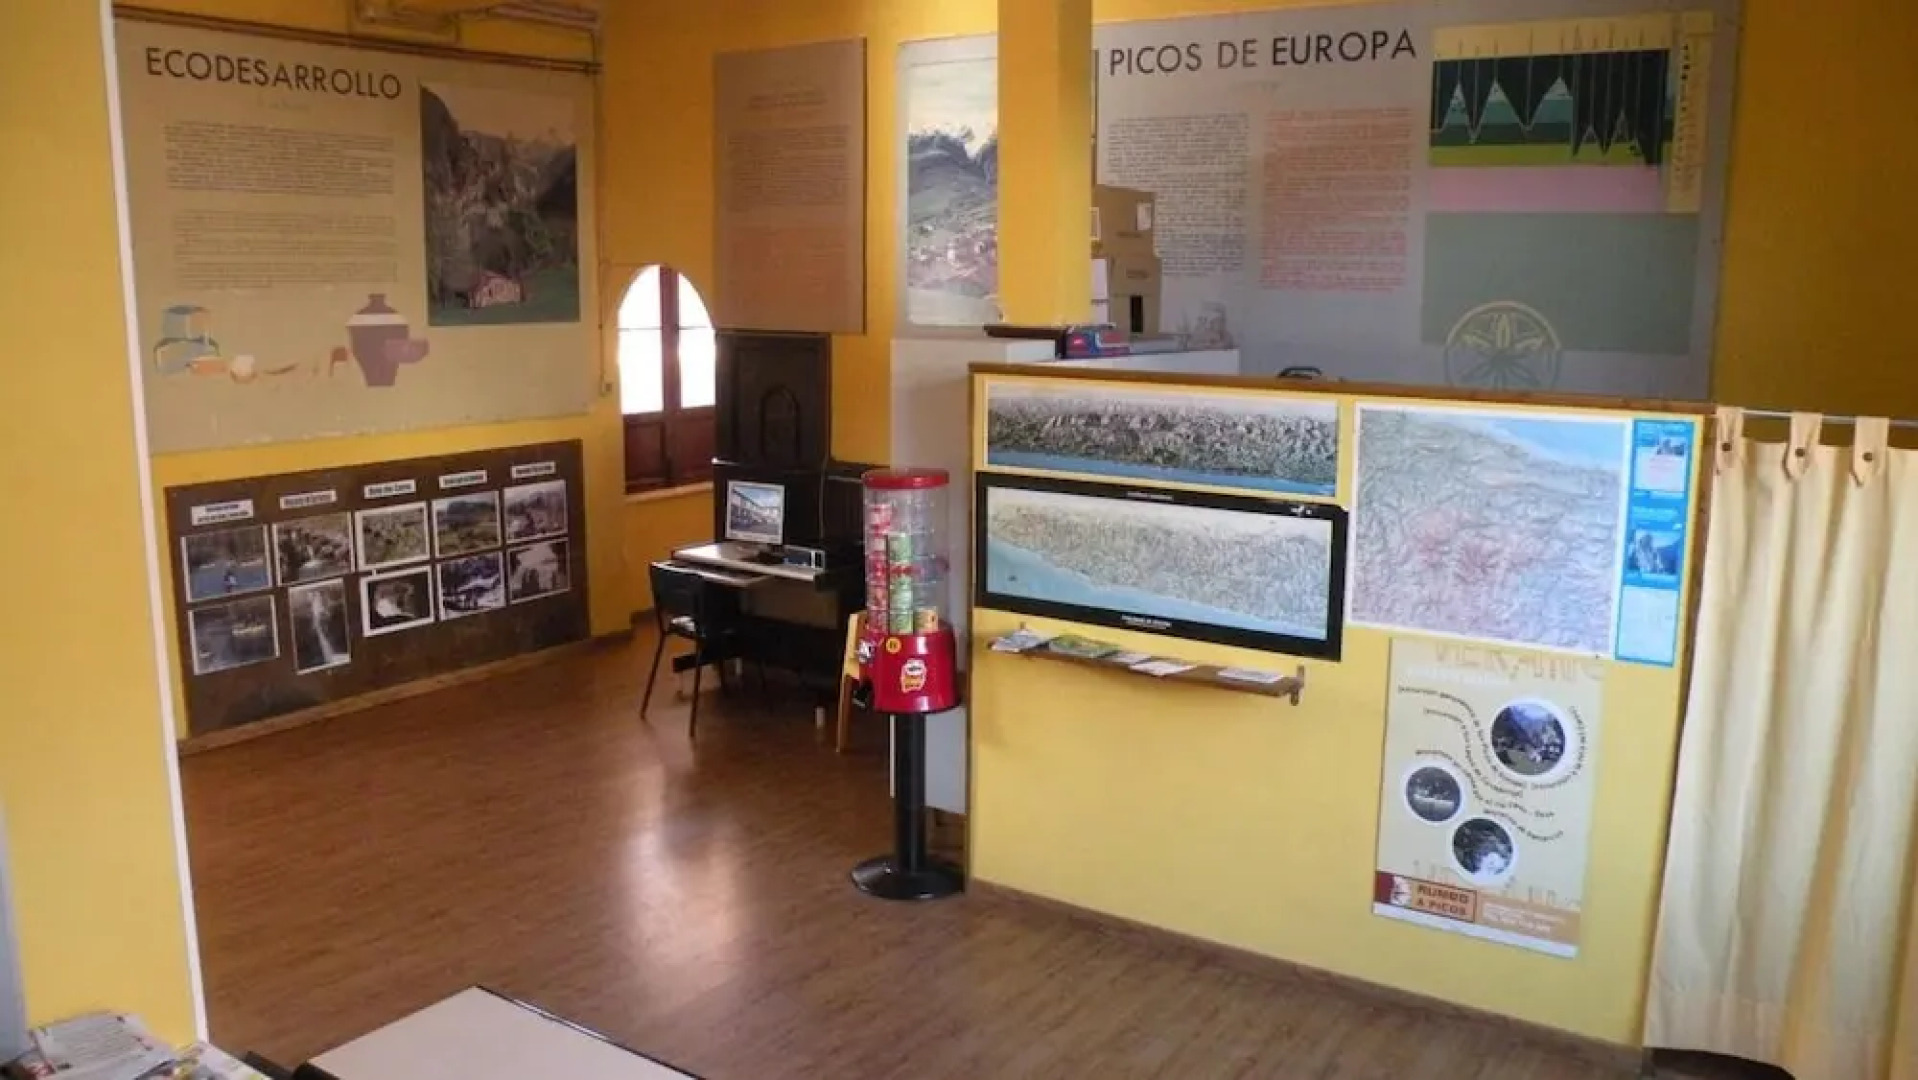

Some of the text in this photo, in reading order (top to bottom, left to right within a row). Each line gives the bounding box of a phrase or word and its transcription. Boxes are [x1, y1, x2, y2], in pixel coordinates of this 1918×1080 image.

[145, 47, 401, 100] ECODESARROLLO
[1109, 28, 1416, 75] PICOS DE EUROPA
